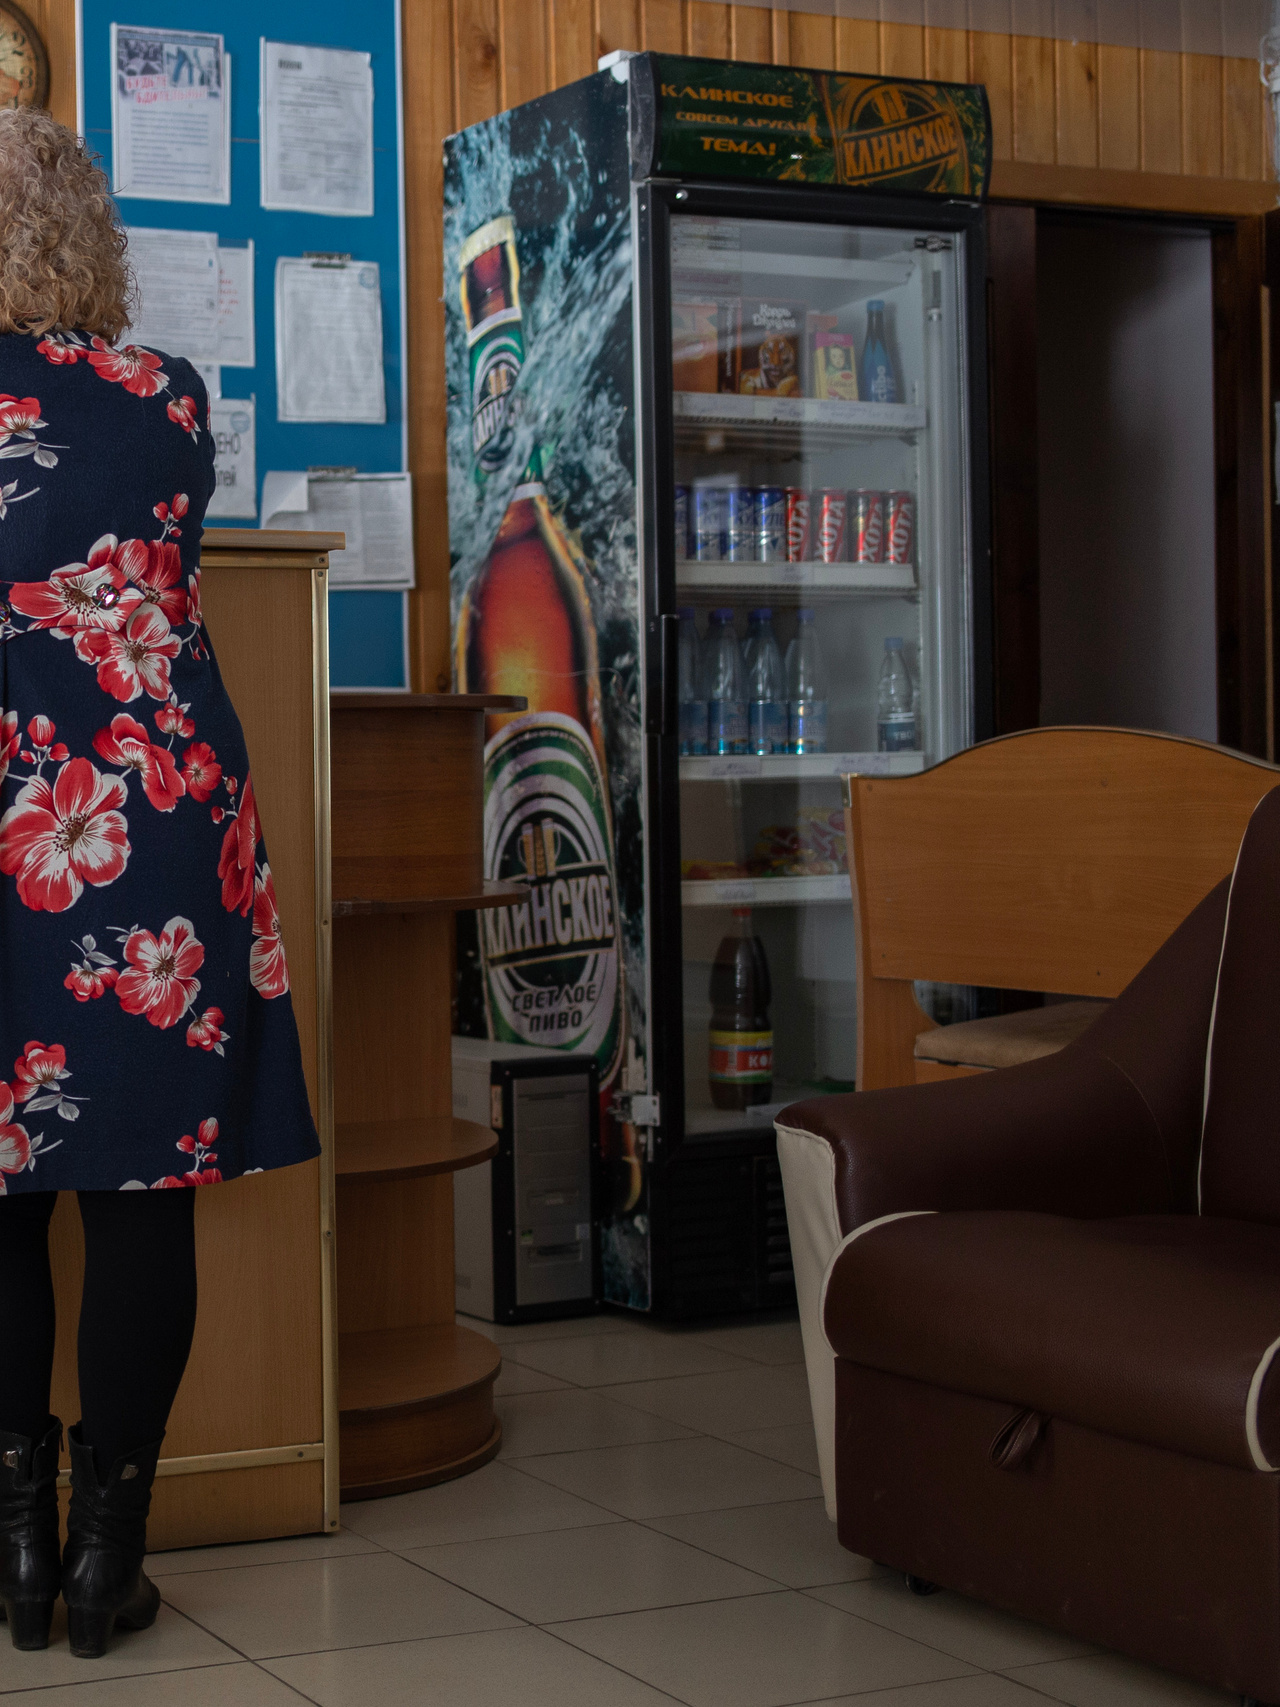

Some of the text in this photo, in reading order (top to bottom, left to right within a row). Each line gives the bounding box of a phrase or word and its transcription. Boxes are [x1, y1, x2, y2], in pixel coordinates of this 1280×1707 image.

[21, 66, 34, 89] 3
[661, 83, 794, 108] КЛИНСКОЕ
[675, 111, 738, 125] СОВСЕМ
[844, 115, 958, 177] КЛИНСКОЕ
[485, 875, 614, 957] КЛИНСКОЕ
[512, 983, 597, 1012] СВЕТЛОЕ
[529, 1009, 583, 1032] ПИВО
